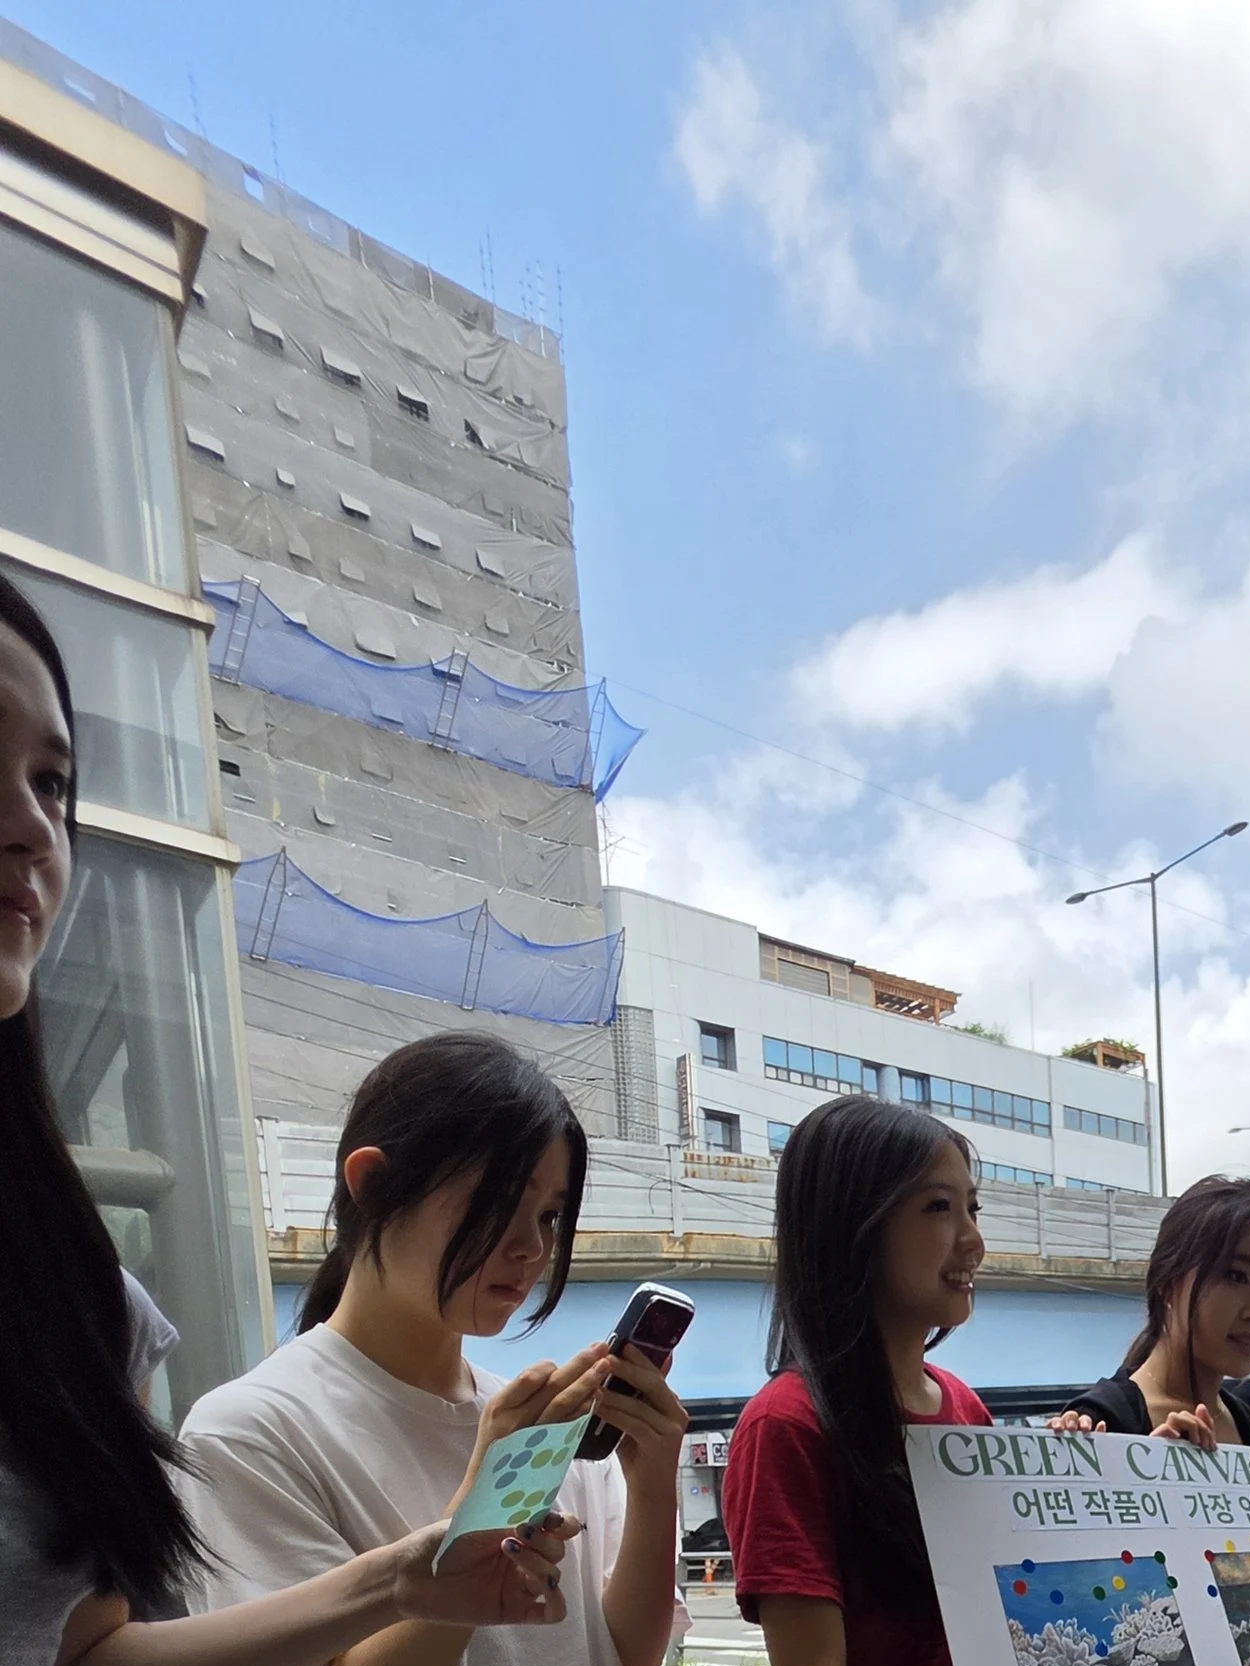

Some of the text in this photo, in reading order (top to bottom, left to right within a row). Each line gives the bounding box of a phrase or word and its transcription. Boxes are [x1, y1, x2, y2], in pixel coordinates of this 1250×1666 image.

[937, 1431, 1103, 1478] GREEN
[1012, 1488, 1078, 1526] 어떤
[1081, 1488, 1170, 1525] 작품이
[1184, 1491, 1235, 1525] 가장
